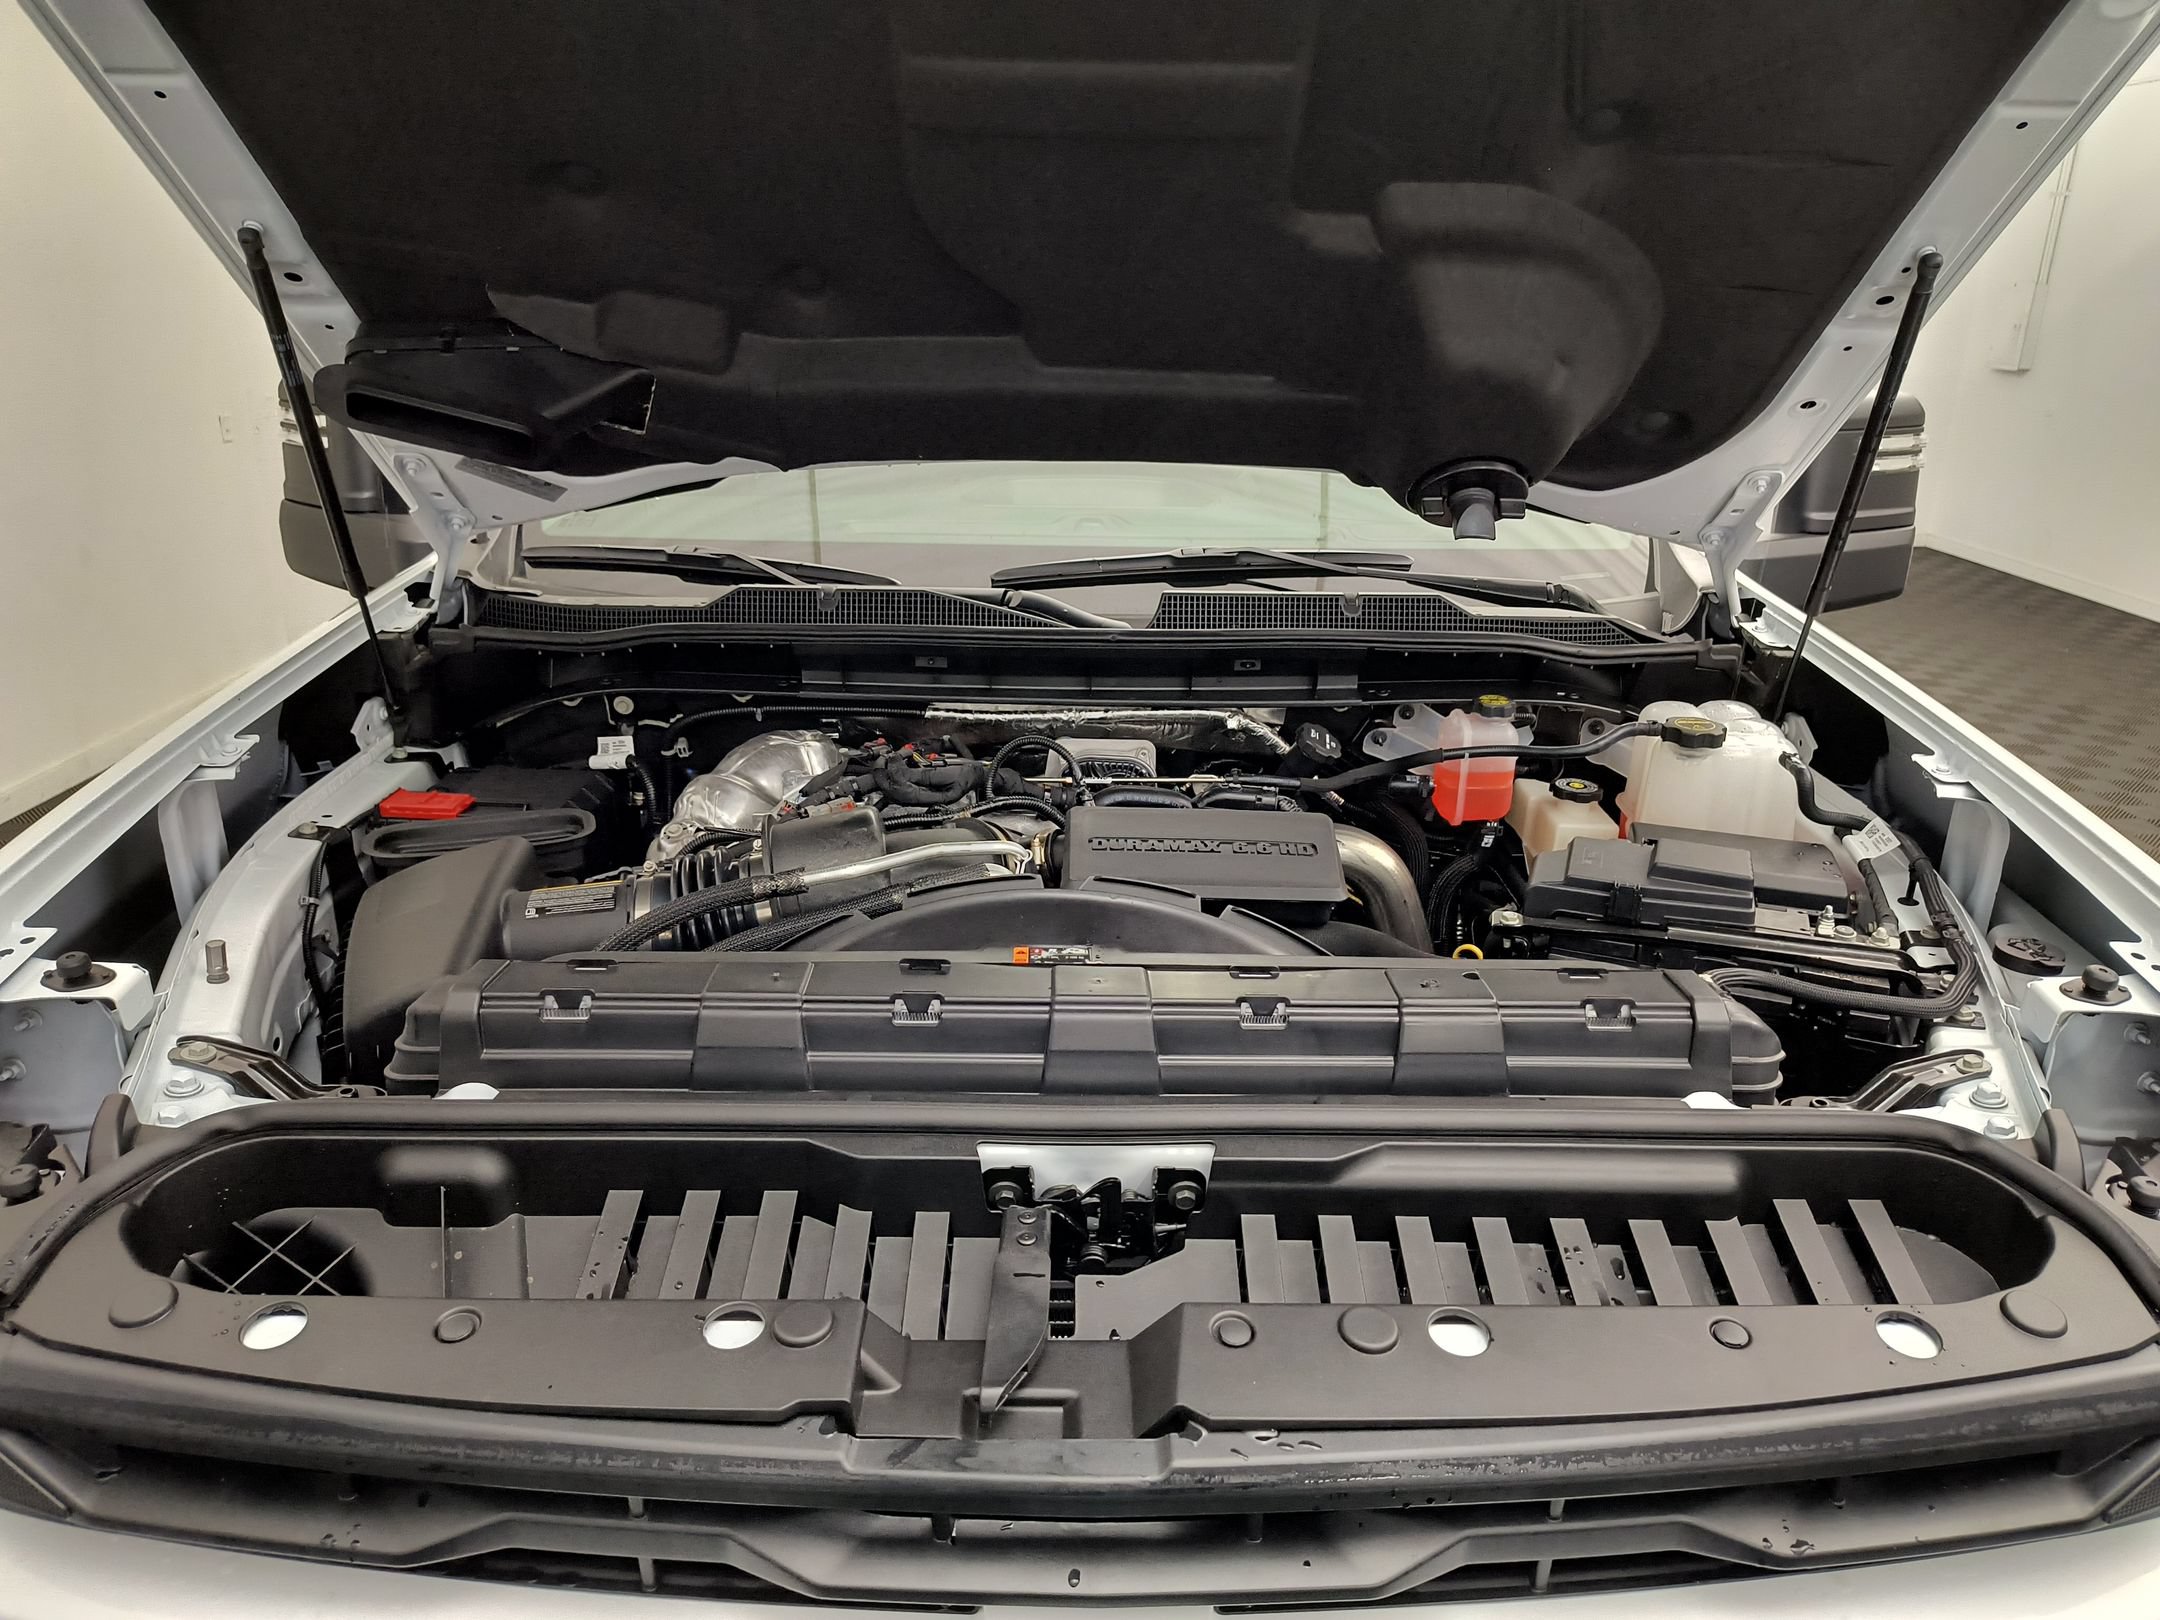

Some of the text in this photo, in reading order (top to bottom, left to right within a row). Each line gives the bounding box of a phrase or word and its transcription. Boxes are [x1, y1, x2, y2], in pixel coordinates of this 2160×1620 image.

[1091, 838, 1316, 856] DURAMAX 6.6 HD
